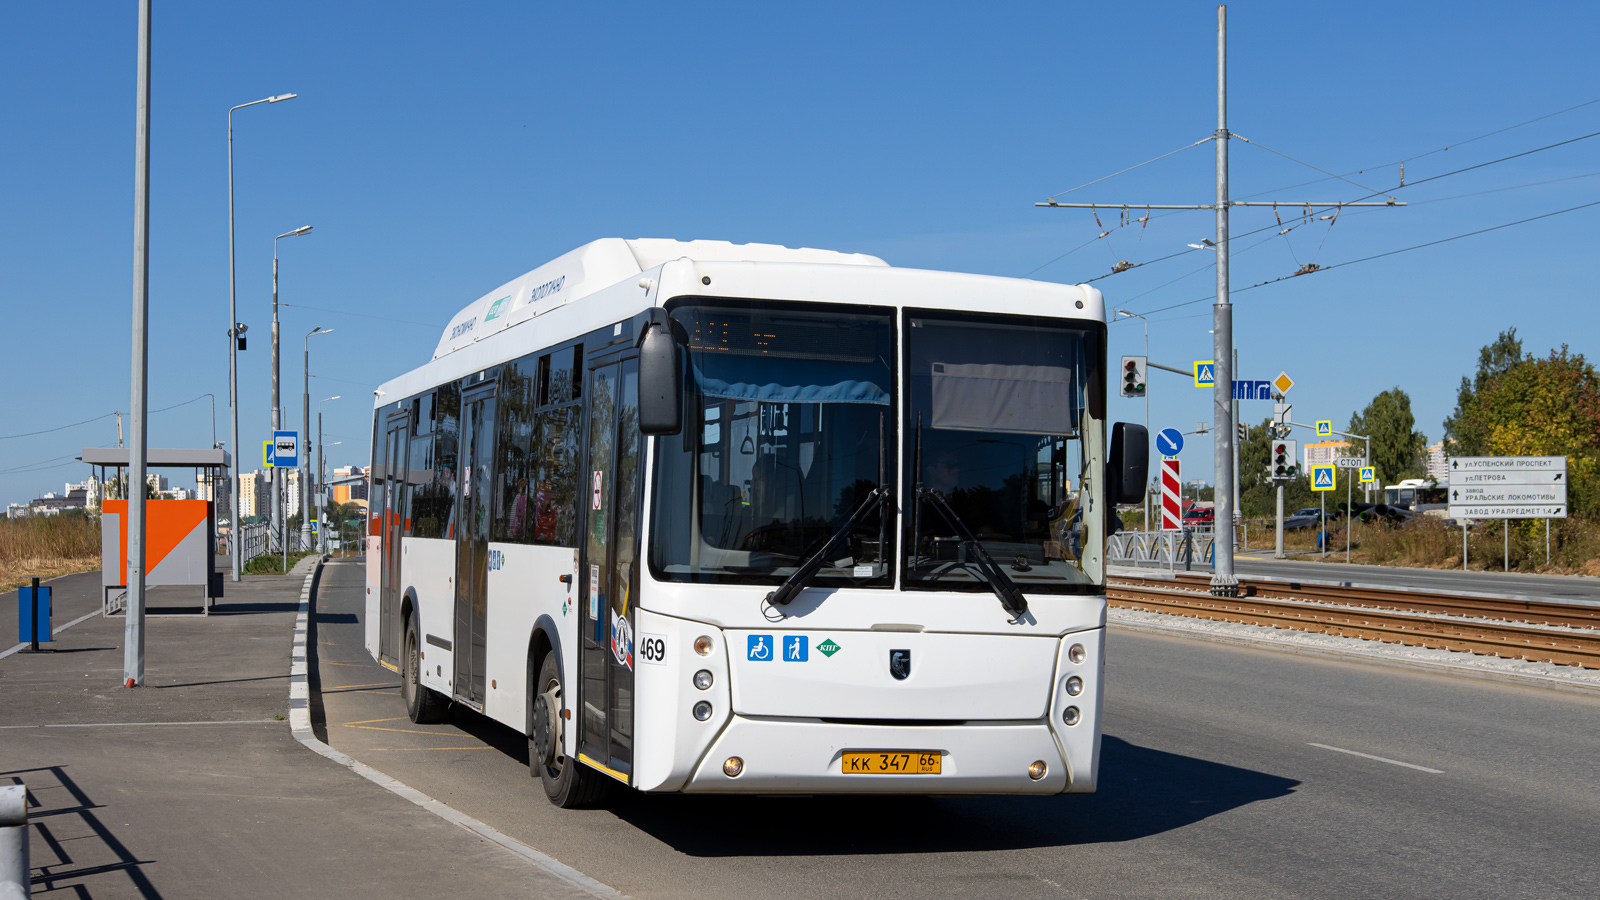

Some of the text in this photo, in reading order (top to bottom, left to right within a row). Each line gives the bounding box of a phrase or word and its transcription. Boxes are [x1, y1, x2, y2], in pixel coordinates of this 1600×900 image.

[640, 637, 665, 661] 469
[851, 753, 935, 771] КК 347 66
